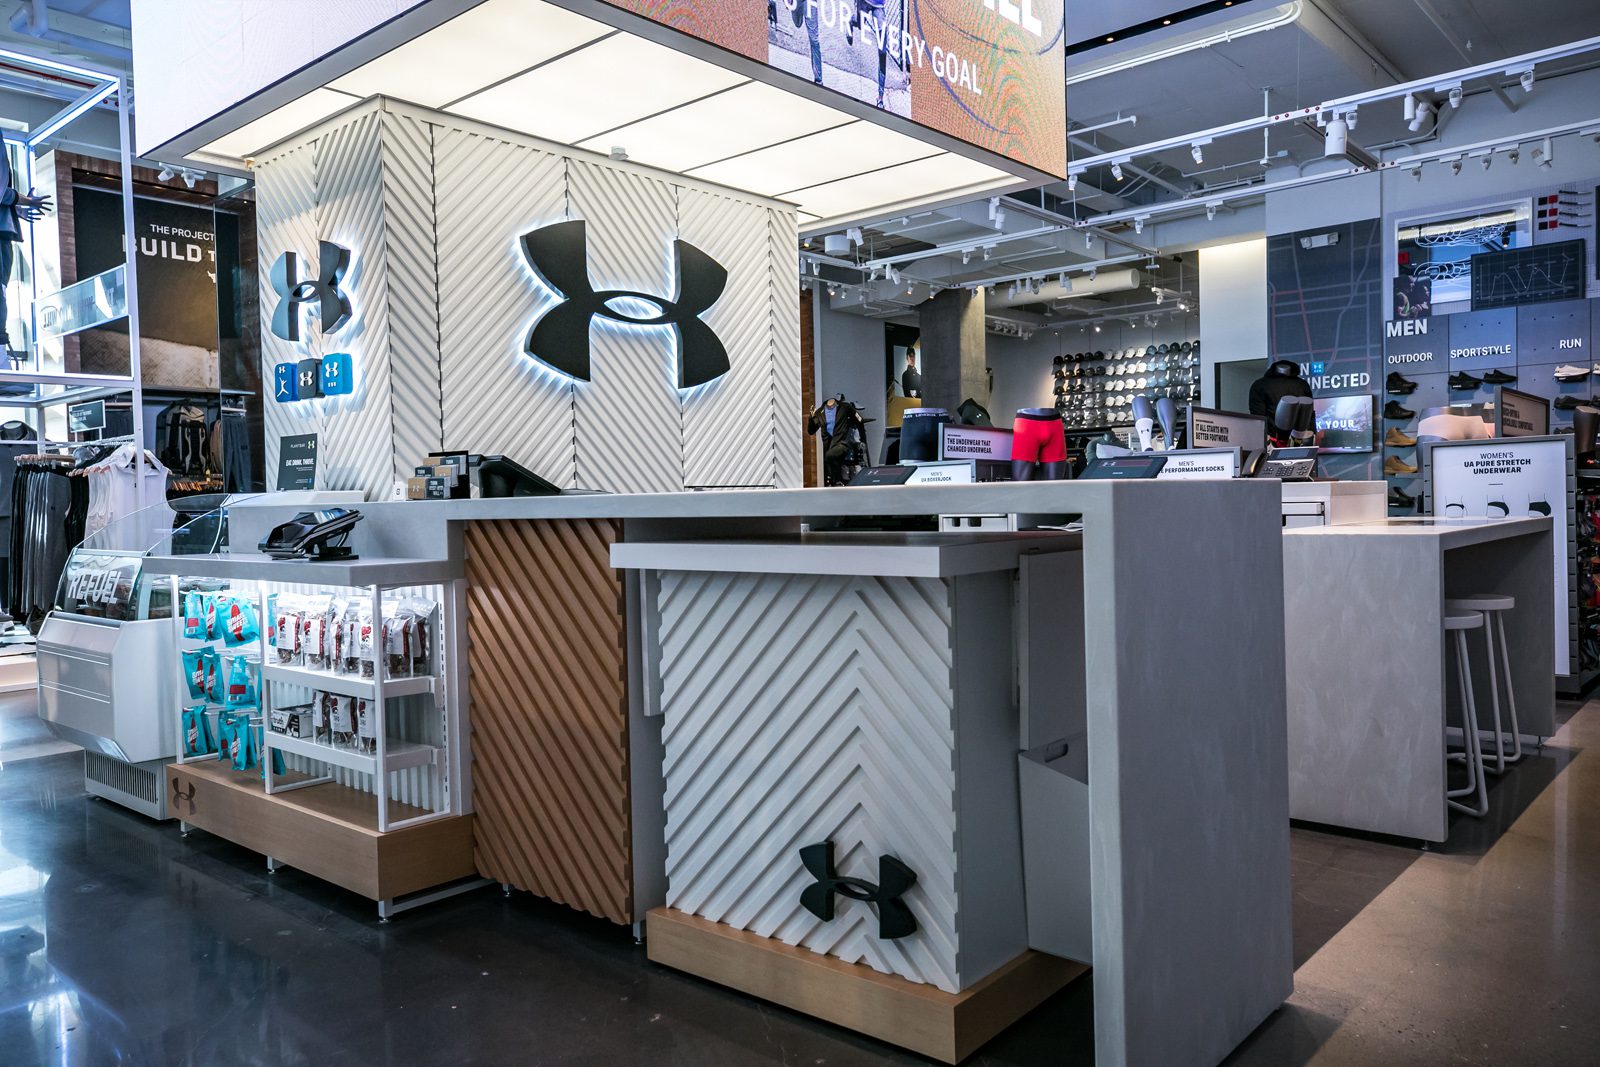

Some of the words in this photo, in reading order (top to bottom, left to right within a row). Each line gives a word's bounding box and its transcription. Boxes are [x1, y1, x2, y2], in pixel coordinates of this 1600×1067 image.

[861, 9, 926, 68] EVERY
[932, 45, 982, 96] GOAL
[150, 223, 170, 235] THE
[171, 227, 215, 241] PROJECT
[1386, 318, 1428, 338] MEN
[1559, 338, 1582, 349] RUN
[1450, 344, 1512, 359] SPORTSTYLE
[1388, 352, 1433, 365] OUTDOOR
[1326, 419, 1355, 430] YOUR
[956, 438, 980, 446] UNDERWEAR
[1195, 432, 1209, 441] BETTER
[947, 445, 967, 453] CHANGED
[1480, 451, 1514, 460] WOMEN'S
[1496, 458, 1531, 466] STRETCH
[1473, 466, 1522, 475] UNDERWEAR
[67, 571, 122, 604] REFUEL
